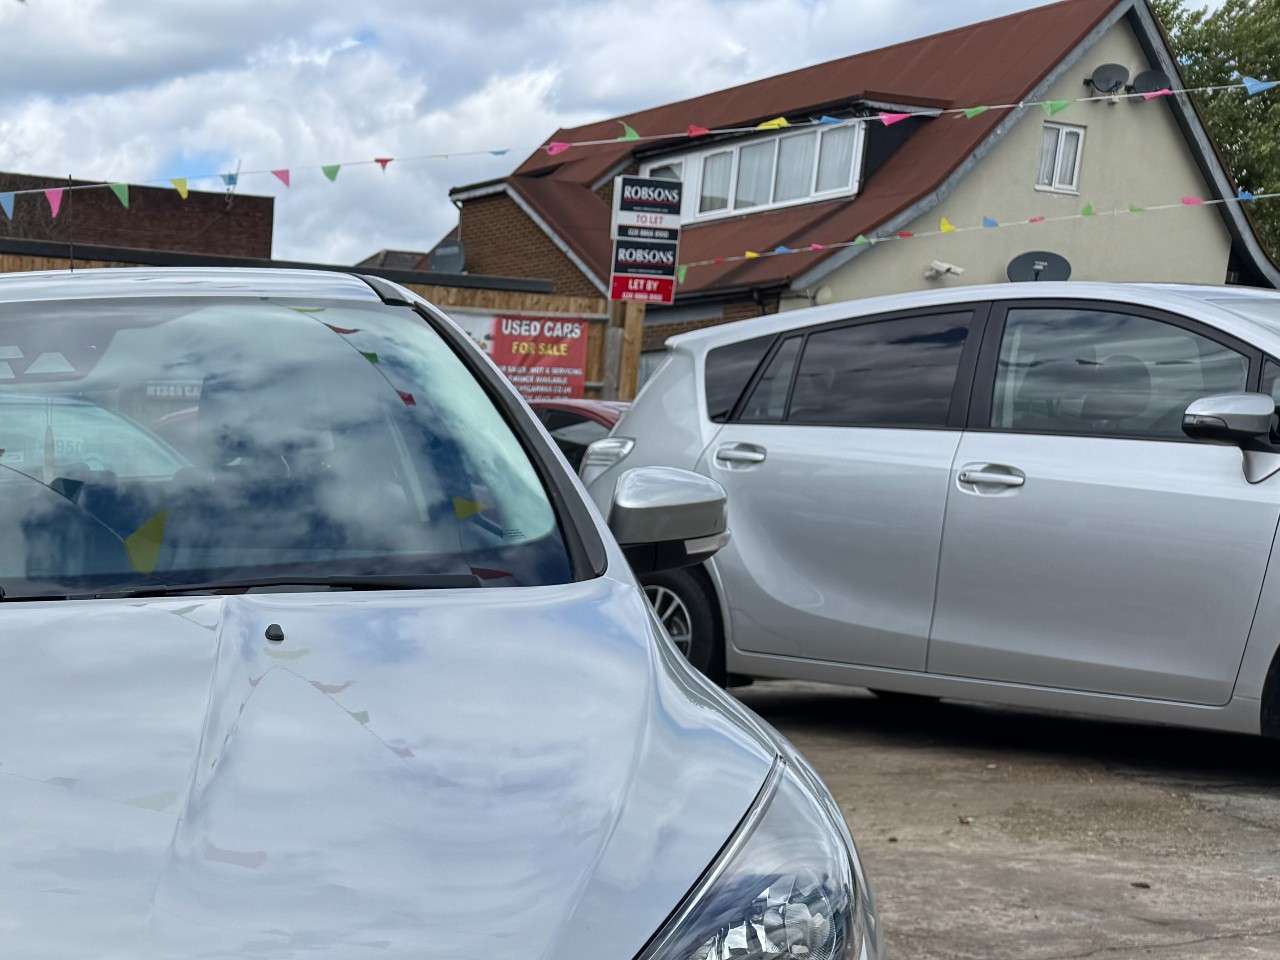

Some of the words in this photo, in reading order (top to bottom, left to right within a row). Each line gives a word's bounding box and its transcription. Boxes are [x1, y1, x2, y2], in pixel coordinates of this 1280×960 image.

[624, 185, 679, 203] ROBSONS
[636, 214, 648, 223] TO
[649, 215, 664, 225] LET
[617, 247, 674, 265] ROBSONS
[628, 278, 645, 290] LET
[646, 280, 660, 291] BY
[501, 318, 541, 336] USED
[543, 320, 581, 338] CARS
[512, 341, 535, 354] FOR
[538, 342, 569, 356] SALE
